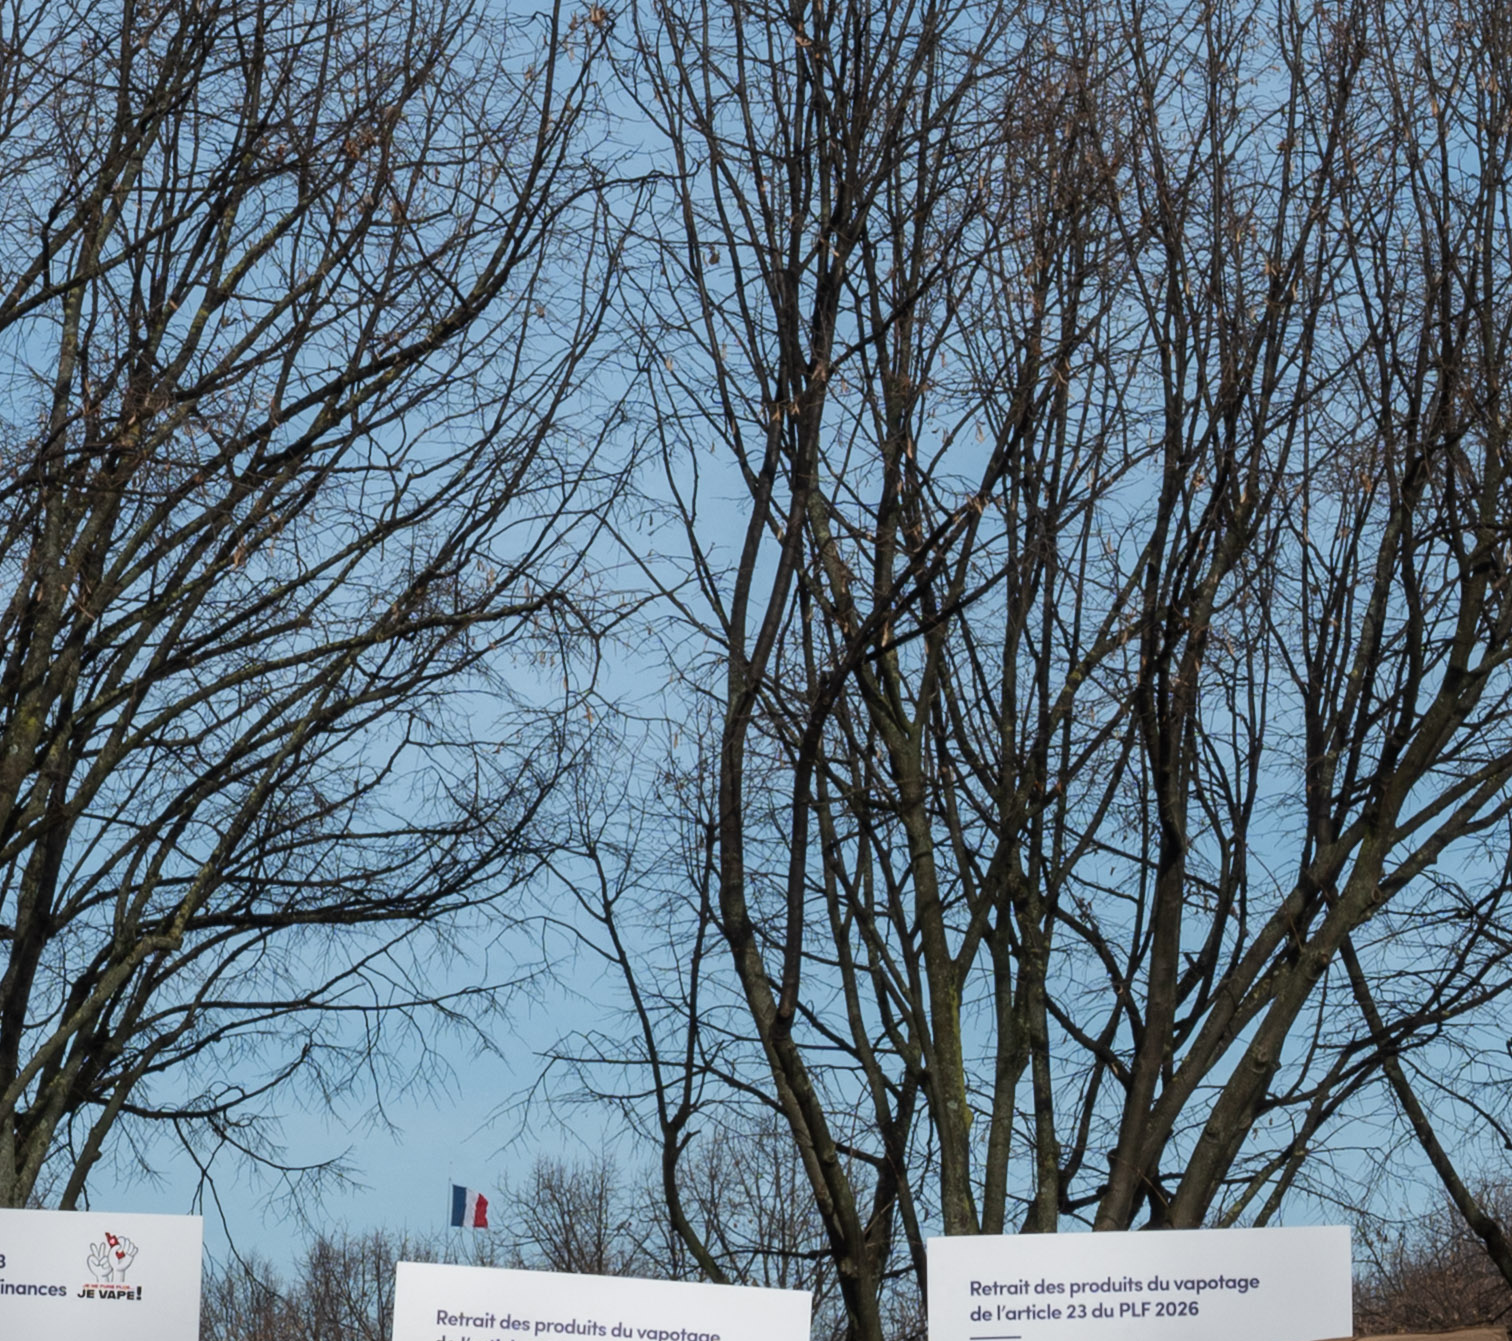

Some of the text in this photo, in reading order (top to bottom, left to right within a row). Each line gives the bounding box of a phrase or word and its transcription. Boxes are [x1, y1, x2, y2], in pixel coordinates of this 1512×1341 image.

[436, 1309, 497, 1329] Retrait
[499, 1313, 531, 1332] des
[534, 1316, 607, 1338] produits
[610, 1321, 633, 1339] du
